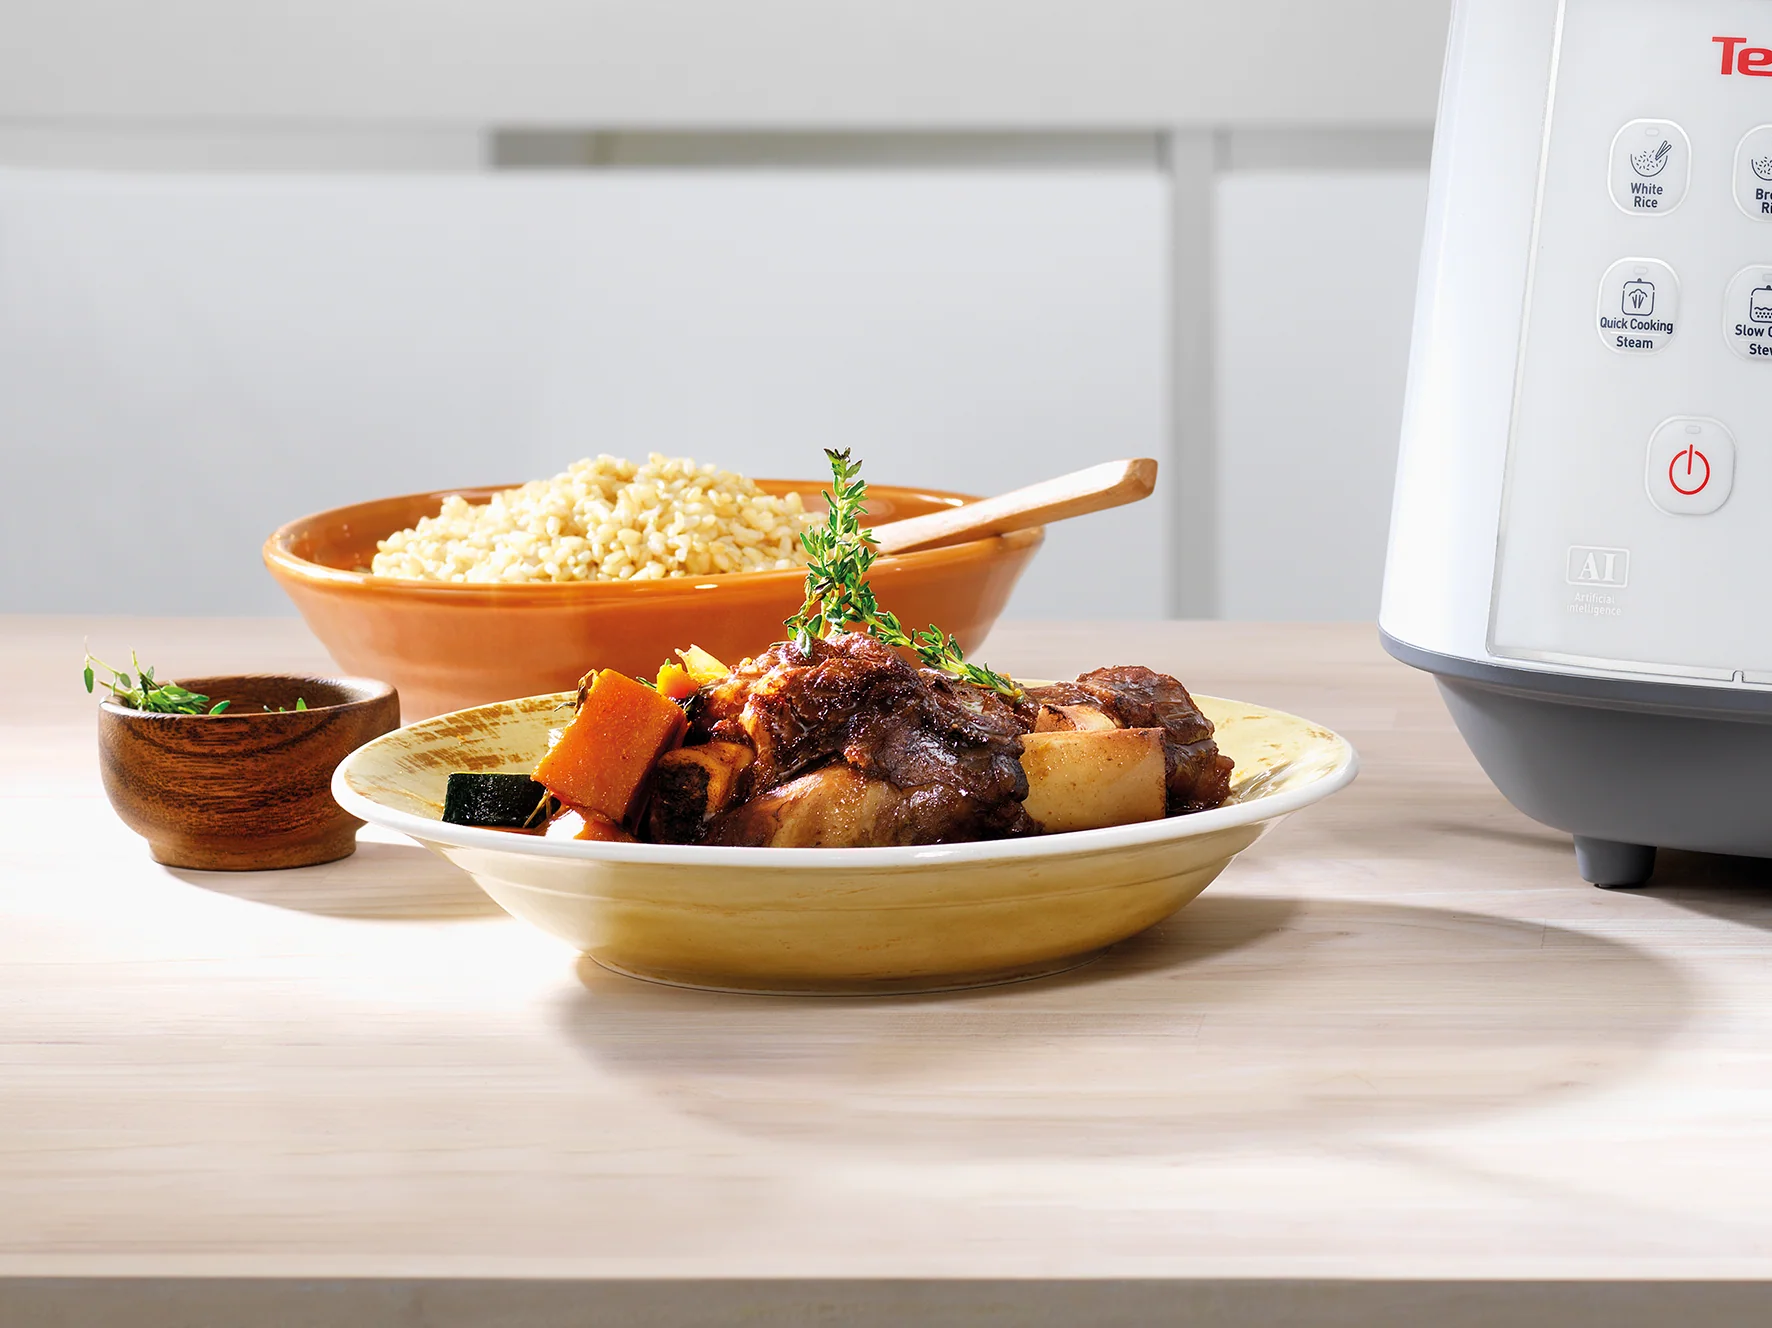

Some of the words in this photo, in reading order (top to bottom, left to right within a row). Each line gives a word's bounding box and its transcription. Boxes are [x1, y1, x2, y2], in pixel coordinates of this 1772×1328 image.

[1630, 182, 1663, 195] White
[1634, 195, 1658, 208] Rice
[1600, 316, 1628, 329] Quick
[1630, 318, 1674, 334] Cooking
[1735, 324, 1764, 337] Slow
[1616, 335, 1653, 349] Steam
[1577, 552, 1617, 582] AI
[1574, 592, 1615, 604] Artificial
